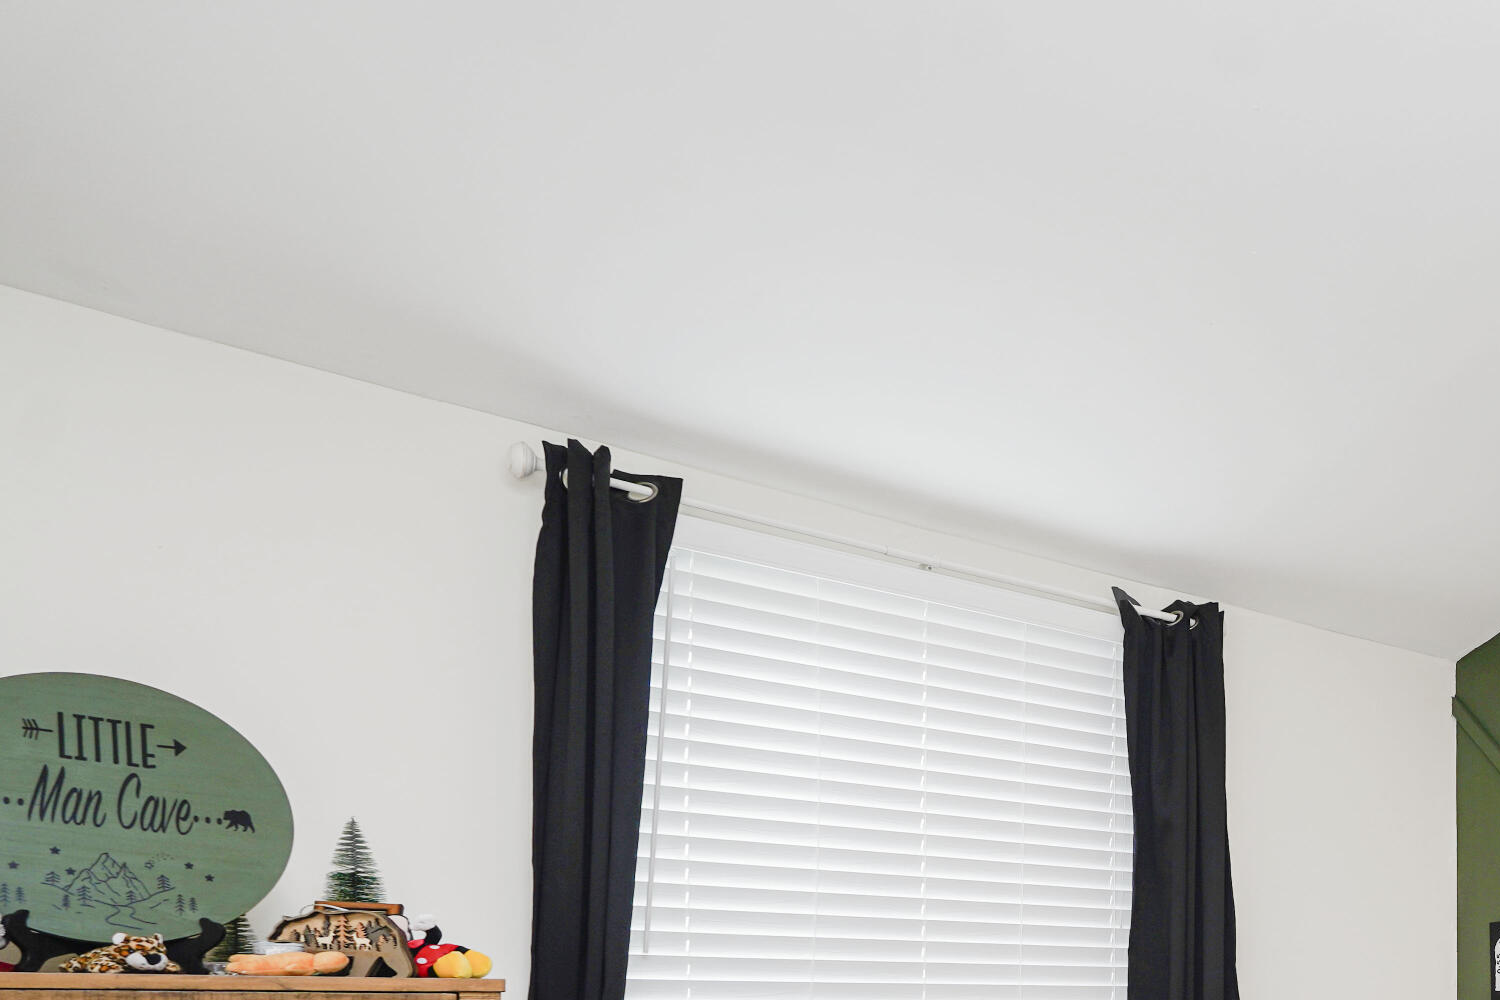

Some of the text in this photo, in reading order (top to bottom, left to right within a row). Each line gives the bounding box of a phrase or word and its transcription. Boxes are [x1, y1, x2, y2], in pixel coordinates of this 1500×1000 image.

[57, 711, 157, 769] LITTLE
[28, 764, 194, 836] Man Cave
